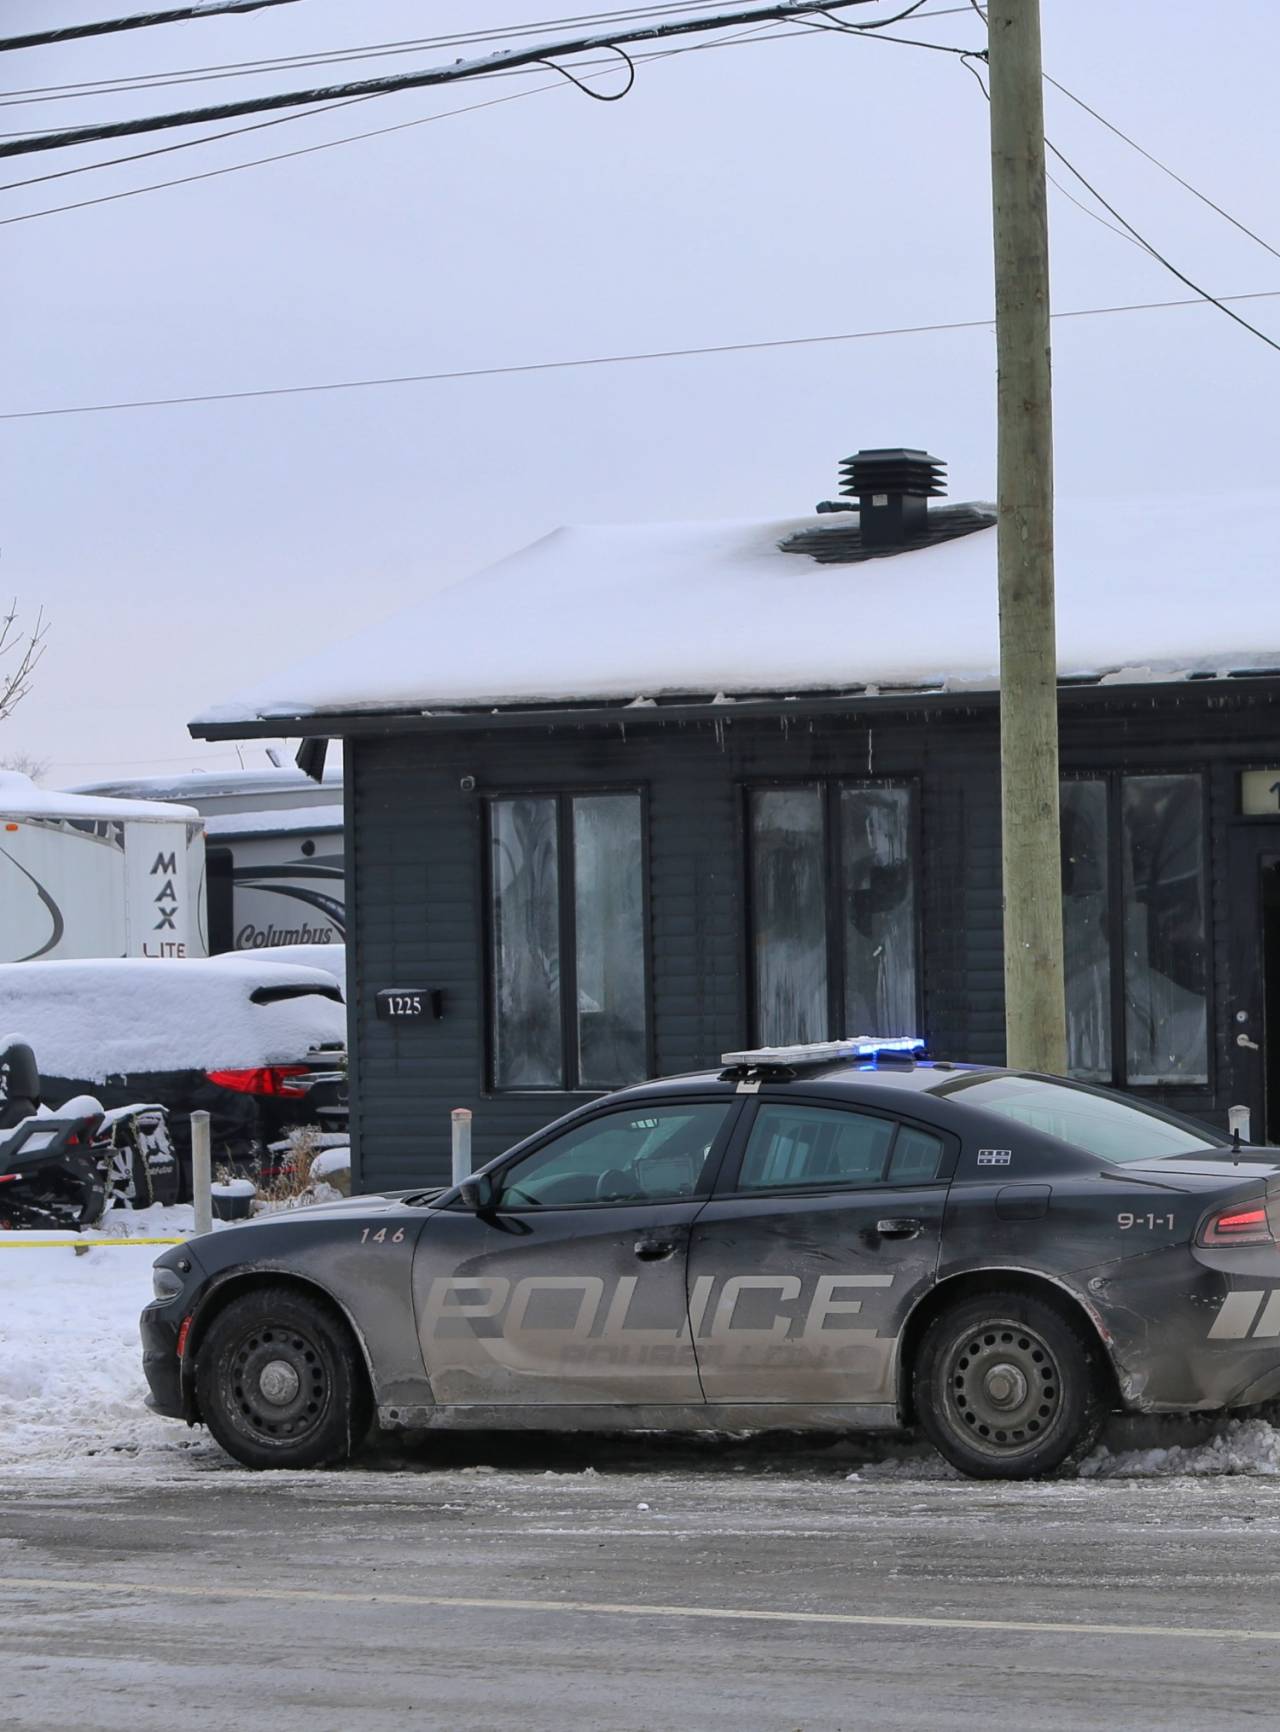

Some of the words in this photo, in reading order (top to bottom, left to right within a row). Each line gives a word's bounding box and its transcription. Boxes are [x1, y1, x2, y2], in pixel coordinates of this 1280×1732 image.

[150, 851, 178, 930] MAX
[236, 923, 333, 950] Columbus
[143, 943, 186, 958] LITE
[388, 997, 421, 1015] 1225
[1118, 1213, 1174, 1230] 9-1-1
[361, 1227, 405, 1244] 146
[420, 1274, 894, 1338] POLICE
